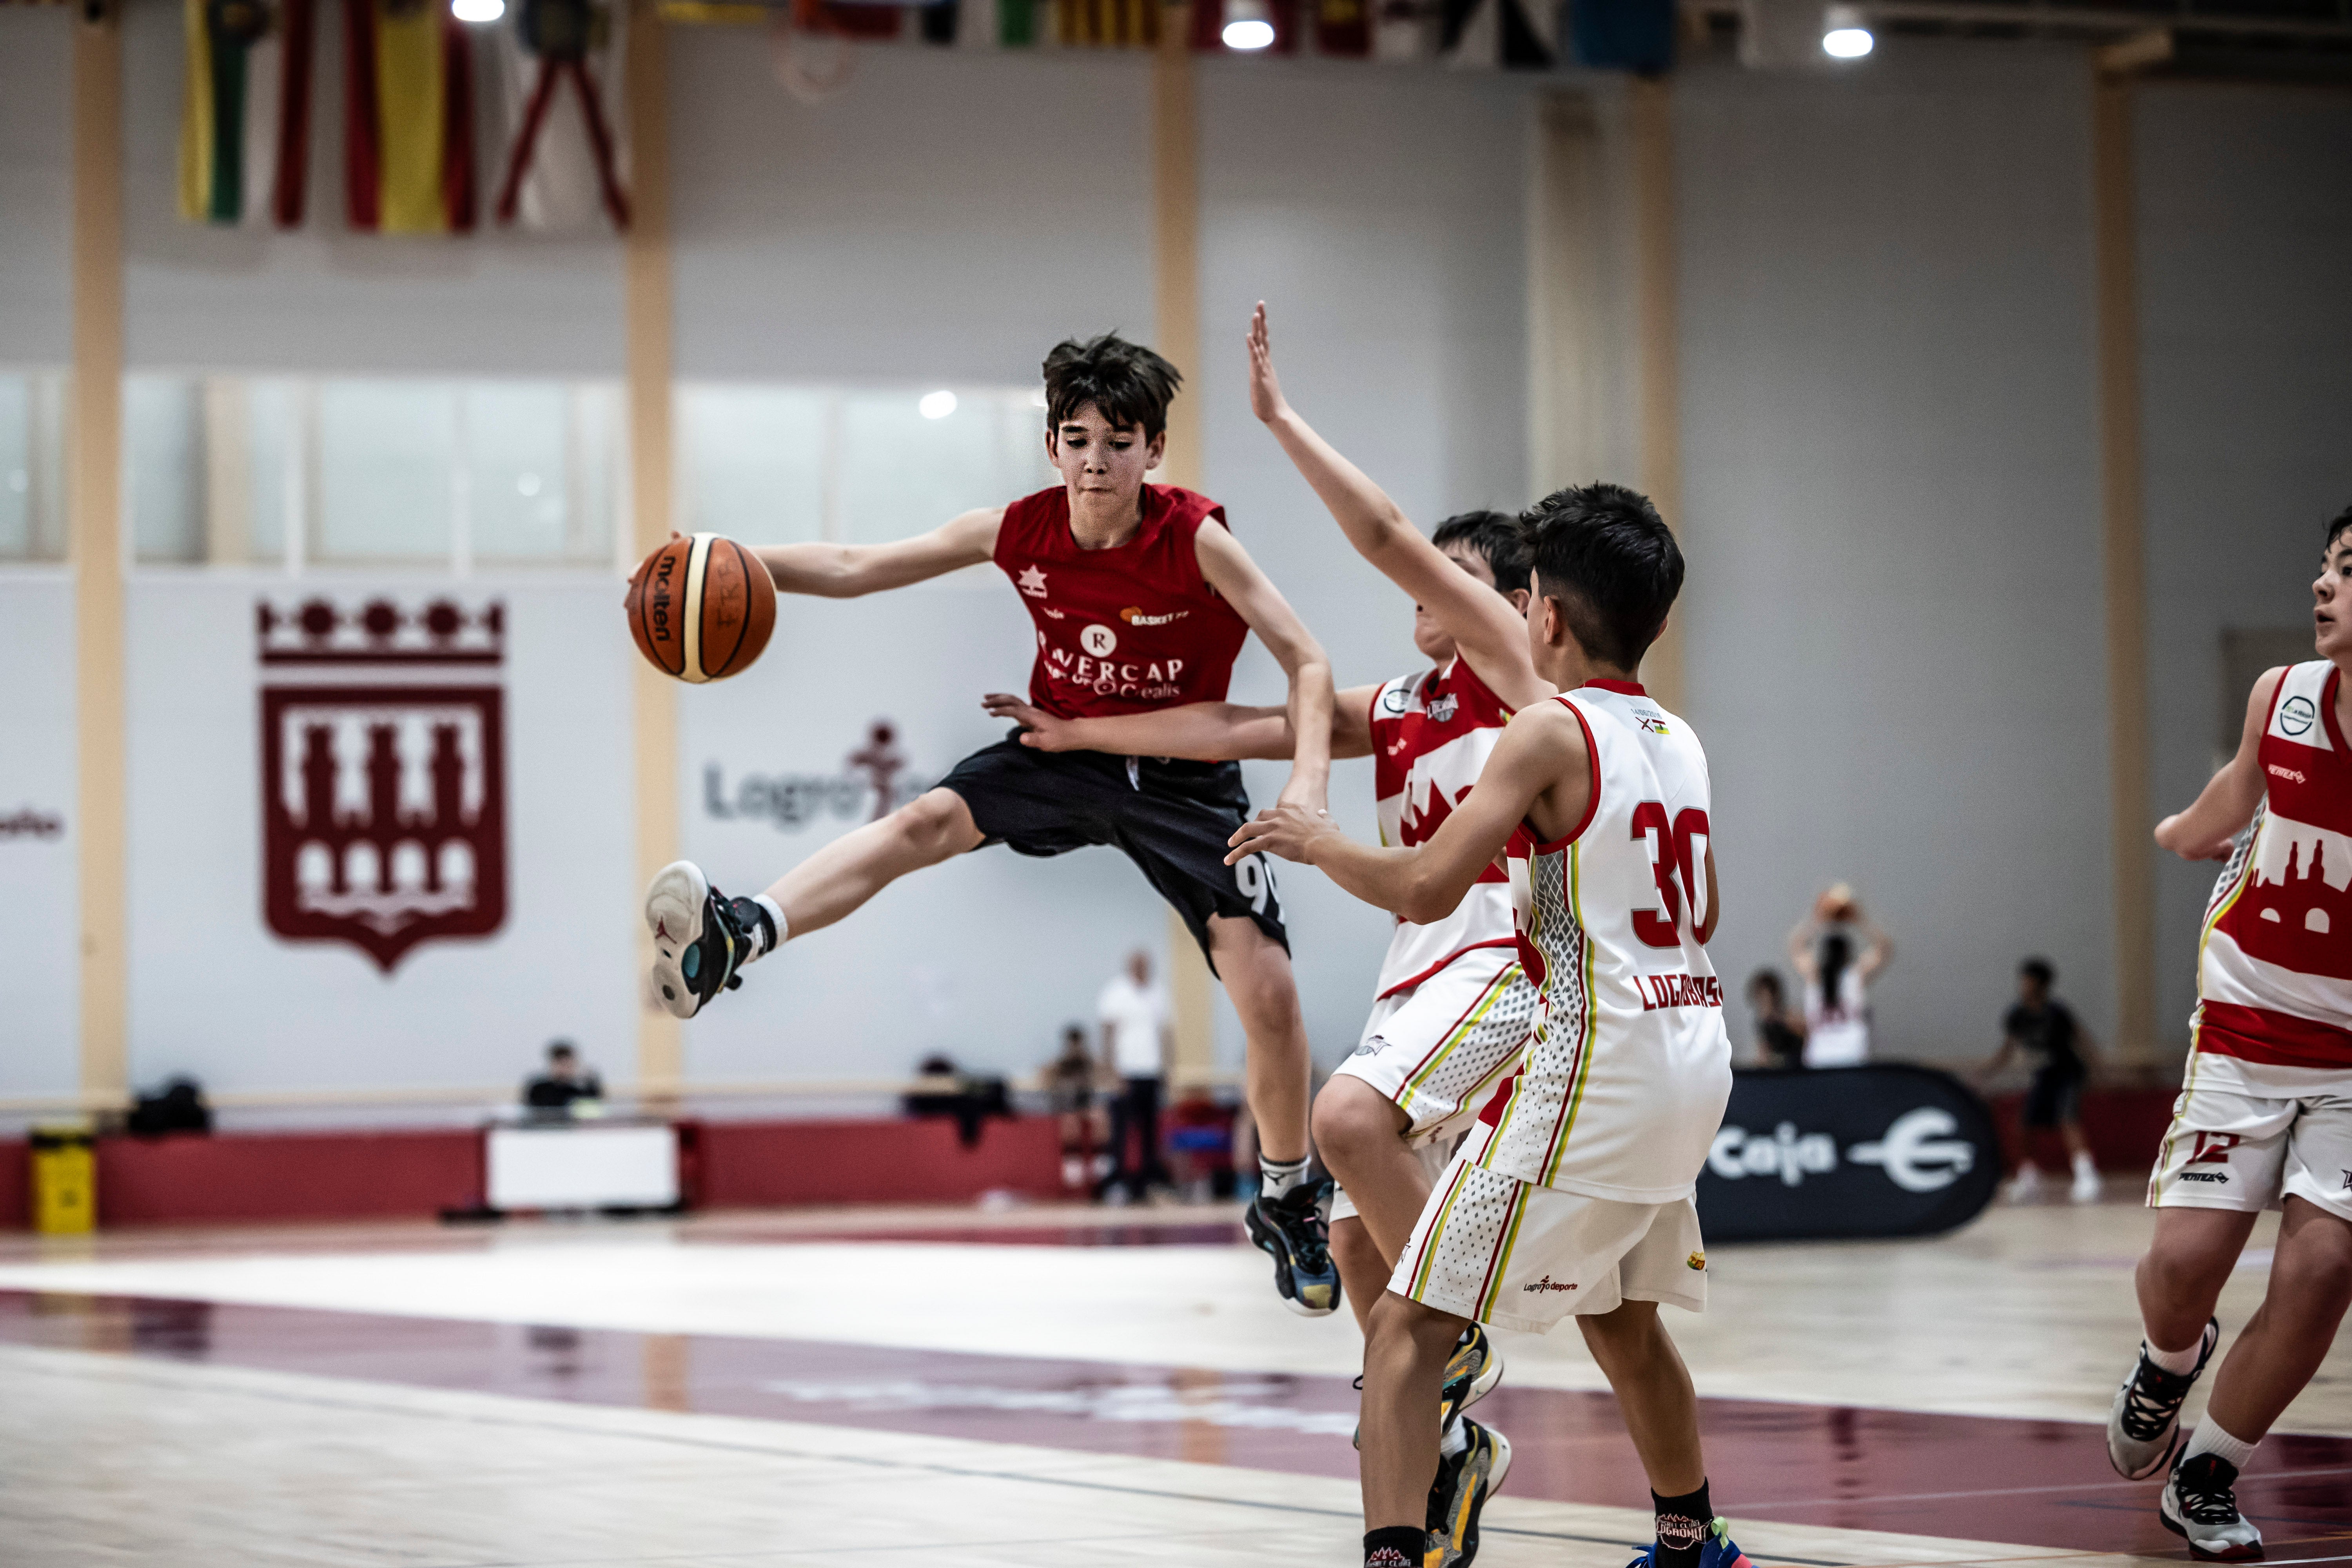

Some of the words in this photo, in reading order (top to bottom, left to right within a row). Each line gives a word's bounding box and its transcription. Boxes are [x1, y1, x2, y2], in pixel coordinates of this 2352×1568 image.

[653, 556, 676, 642] molten
[1093, 632, 1106, 650] R
[1236, 854, 1284, 924] 9
[1630, 800, 1710, 949] 30
[2186, 1130, 2240, 1165] 12
